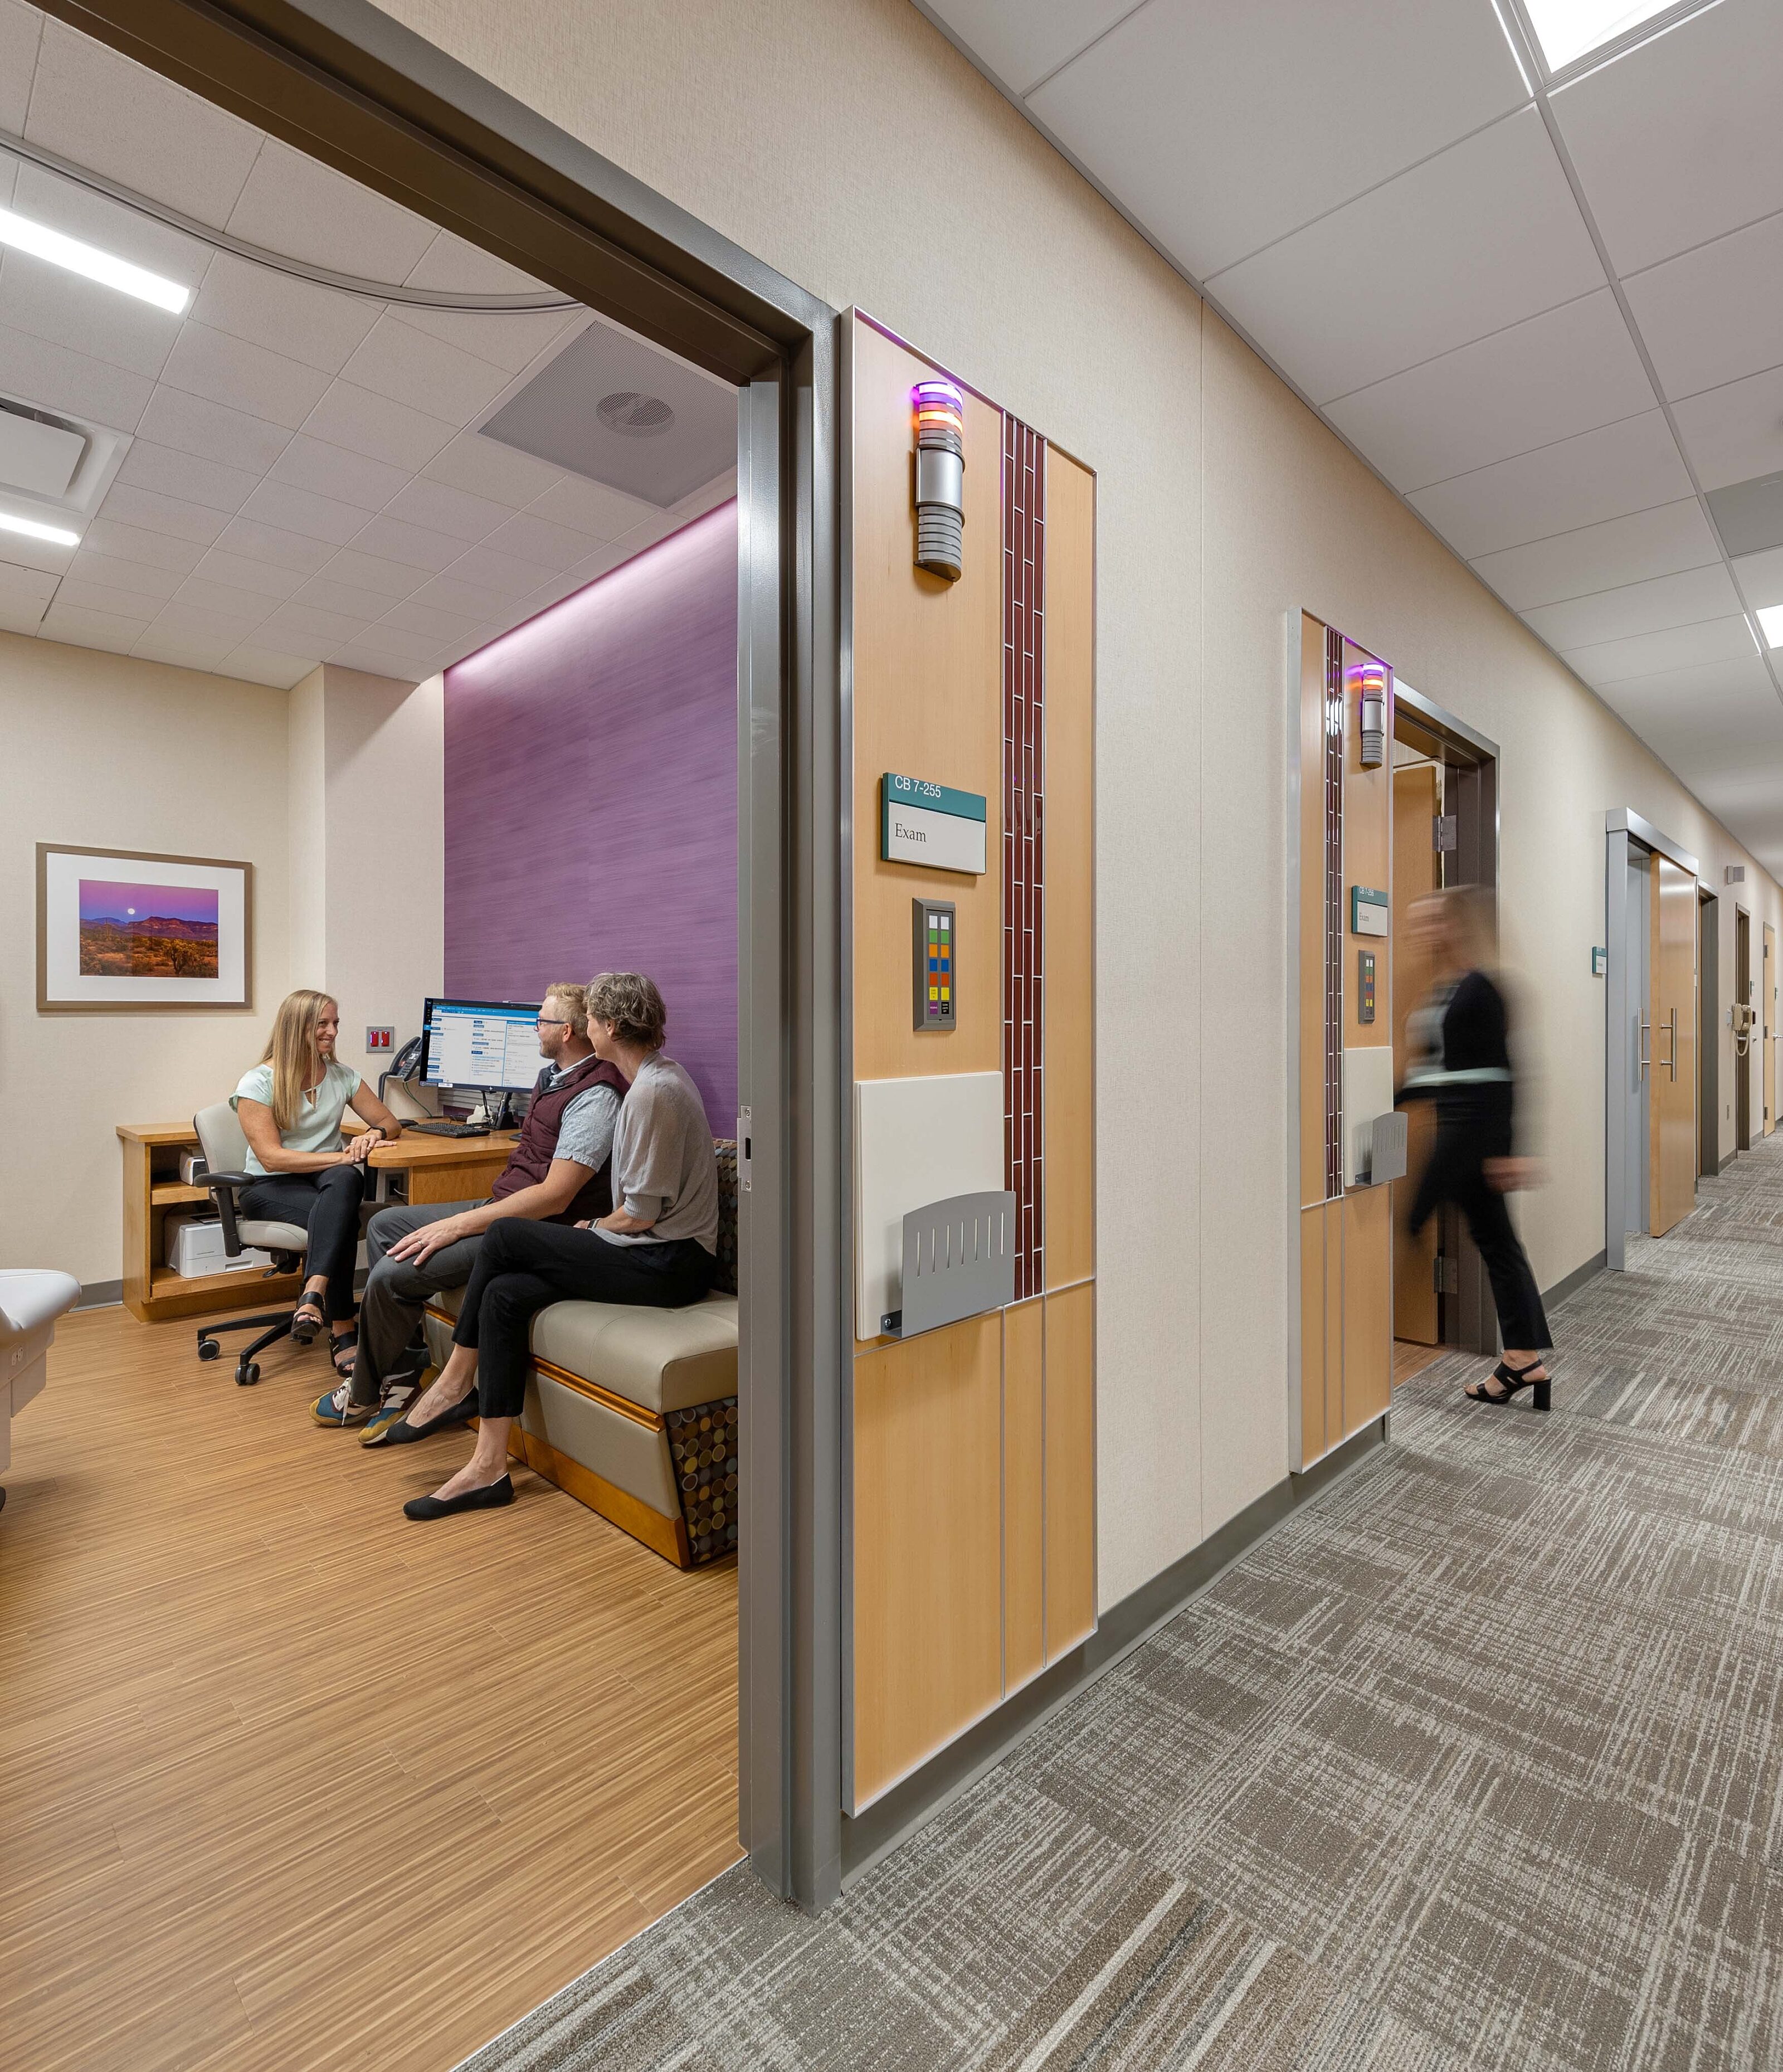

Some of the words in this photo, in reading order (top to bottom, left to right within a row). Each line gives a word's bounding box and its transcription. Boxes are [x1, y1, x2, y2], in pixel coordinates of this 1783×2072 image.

[895, 775, 910, 790] CB
[914, 780, 941, 798] 7-255
[895, 823, 927, 843] Exam
[1359, 912, 1369, 922] Exam
